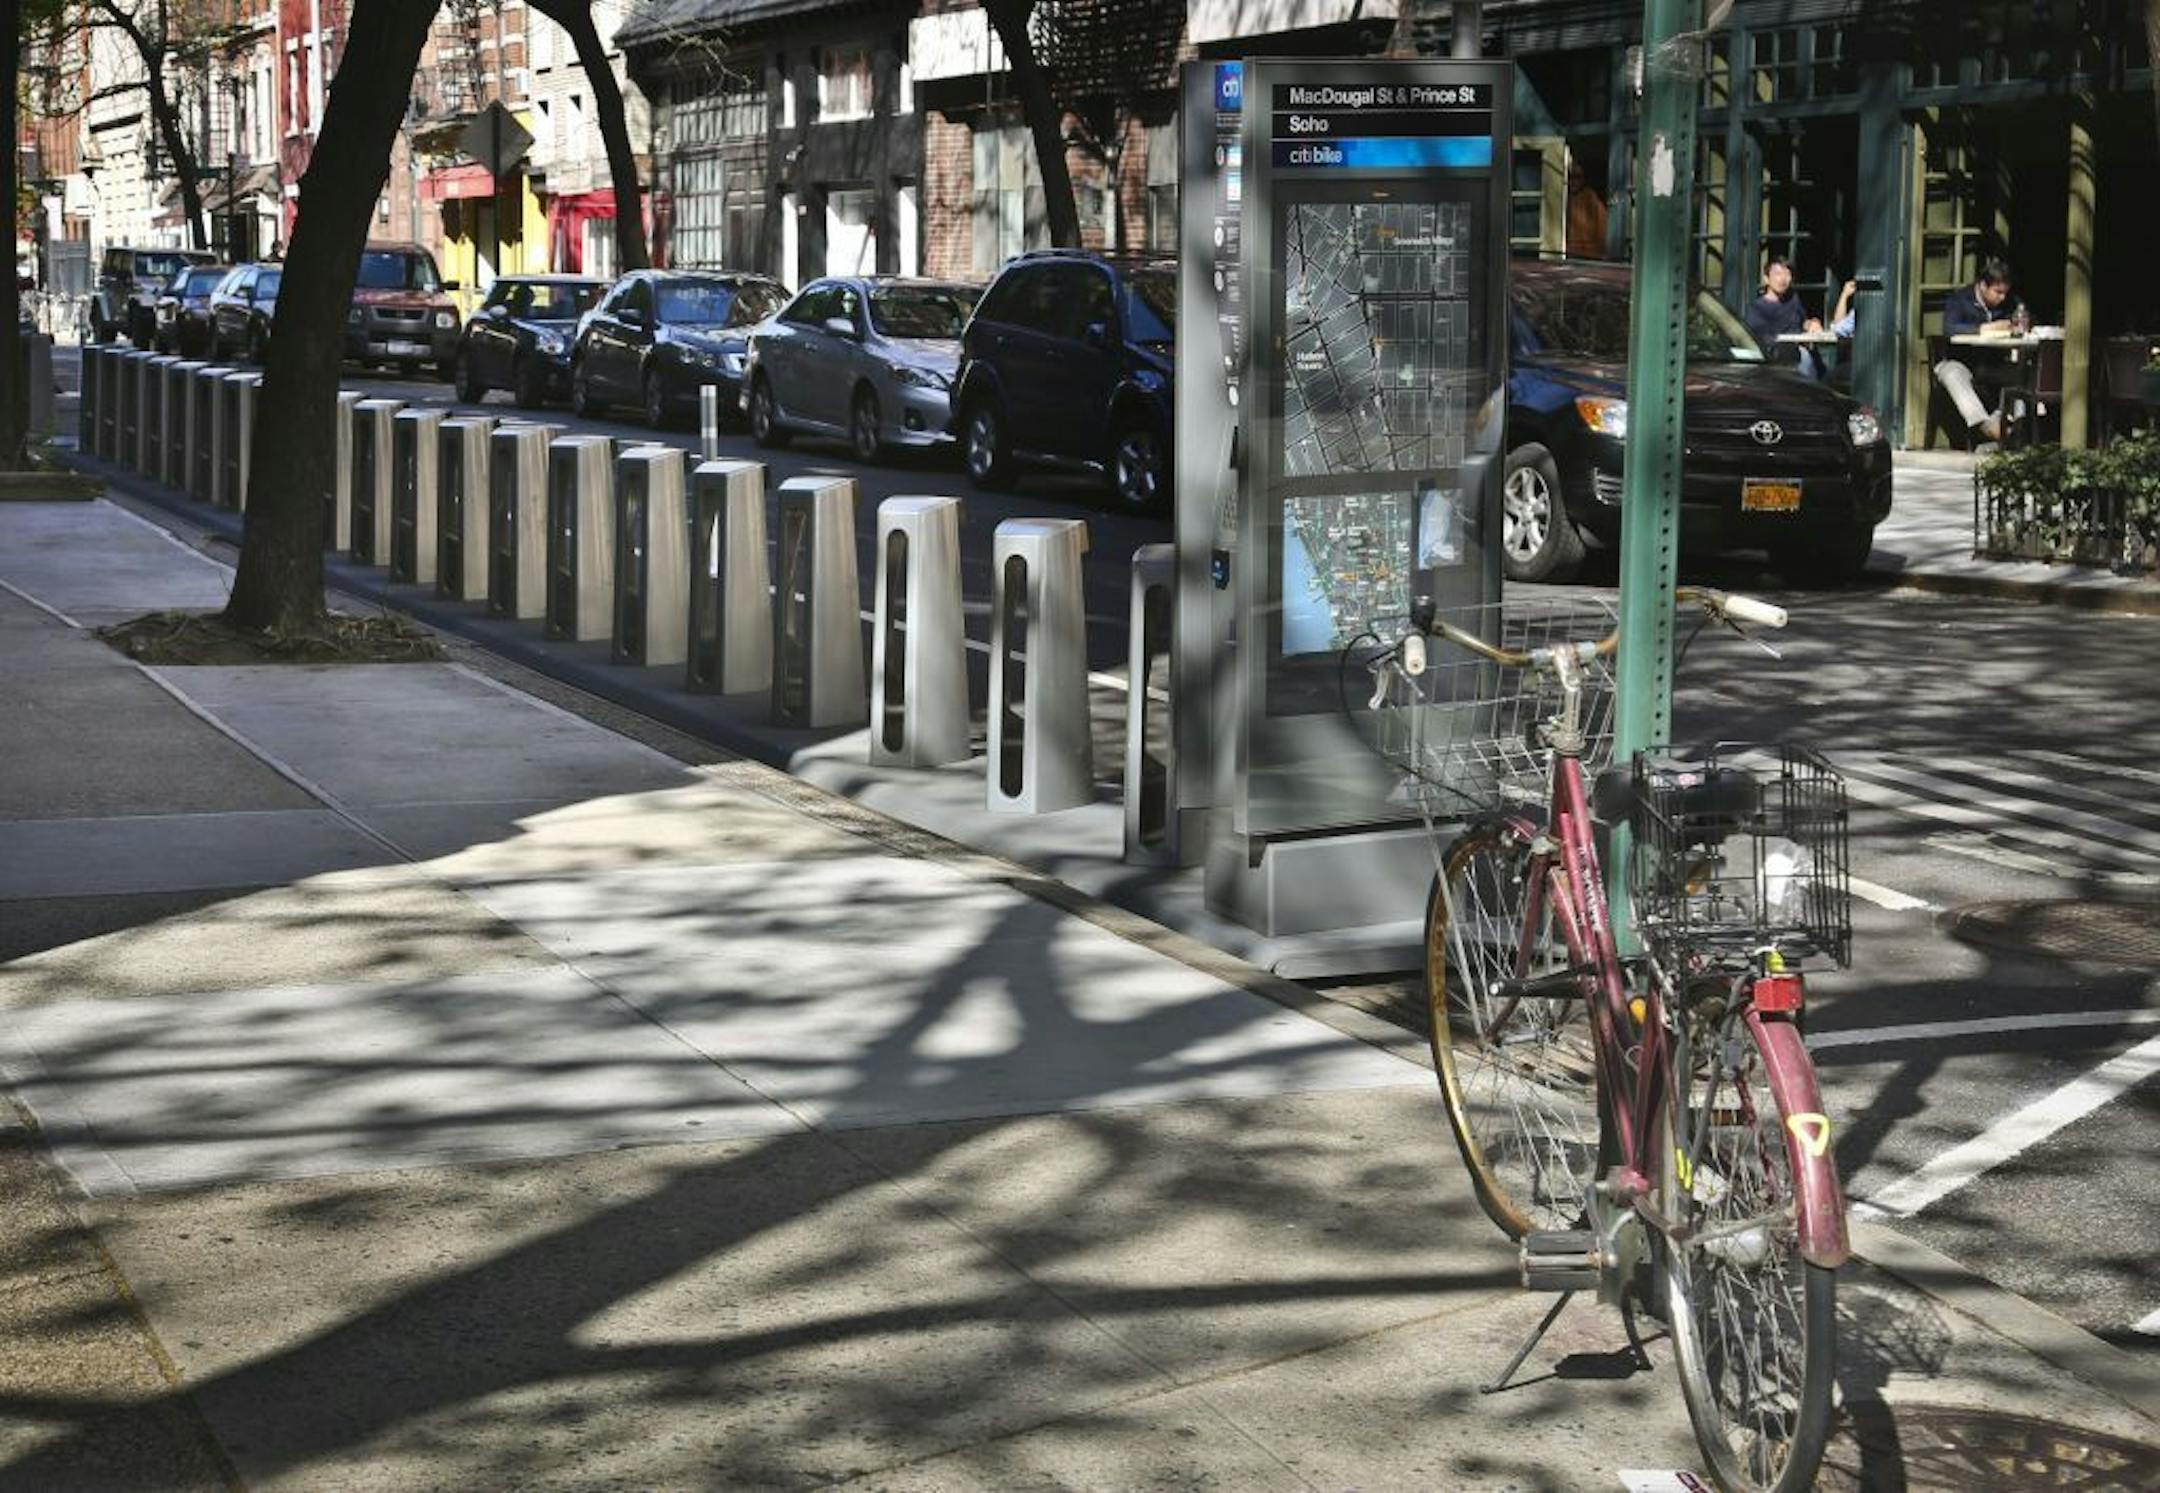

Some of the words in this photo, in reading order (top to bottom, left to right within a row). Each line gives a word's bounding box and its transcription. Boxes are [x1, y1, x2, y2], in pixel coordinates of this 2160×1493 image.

[1290, 87, 1374, 108] MacDougal
[1377, 87, 1393, 104] St
[1396, 87, 1408, 104] &
[1411, 86, 1456, 104] Prince
[1459, 85, 1475, 104] St
[1290, 115, 1328, 133] Soho
